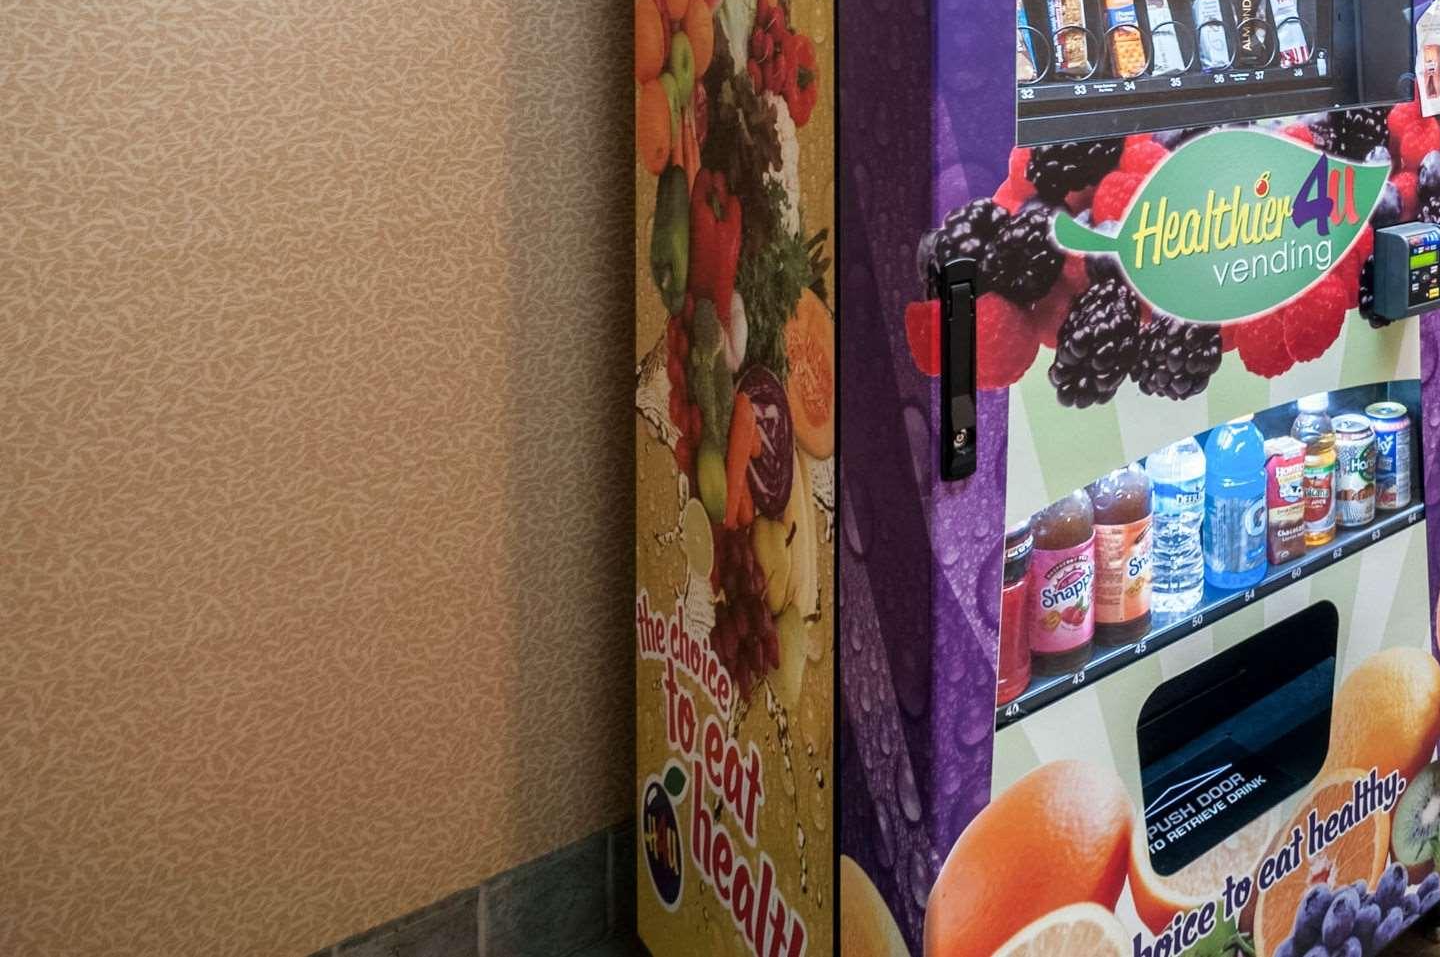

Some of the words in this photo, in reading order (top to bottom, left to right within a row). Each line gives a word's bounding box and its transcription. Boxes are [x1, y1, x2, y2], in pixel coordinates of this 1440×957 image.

[1019, 88, 1035, 100] 32
[1073, 84, 1088, 96] 33
[1123, 81, 1137, 92] 34
[1169, 77, 1182, 88] 35
[1253, 70, 1265, 81] 37
[1213, 238, 1333, 288] vending
[1041, 565, 1092, 609] Snappl
[636, 599, 667, 655] the
[669, 606, 731, 713] choice
[1004, 704, 1020, 717] 40
[1072, 673, 1086, 685] 43
[1134, 642, 1147, 655] 45
[1192, 615, 1203, 628] 50
[1291, 567, 1302, 580] 60
[664, 661, 697, 755] to
[705, 721, 763, 840] eat
[1147, 804, 1196, 841] PUSH
[1198, 771, 1246, 807] DOOR
[1148, 837, 1167, 855] TO
[1166, 801, 1227, 843] RETRIEVE
[1226, 776, 1268, 806] DRINK
[1222, 875, 1252, 919] to
[1259, 830, 1304, 891] eat
[1307, 768, 1406, 858] healthy.
